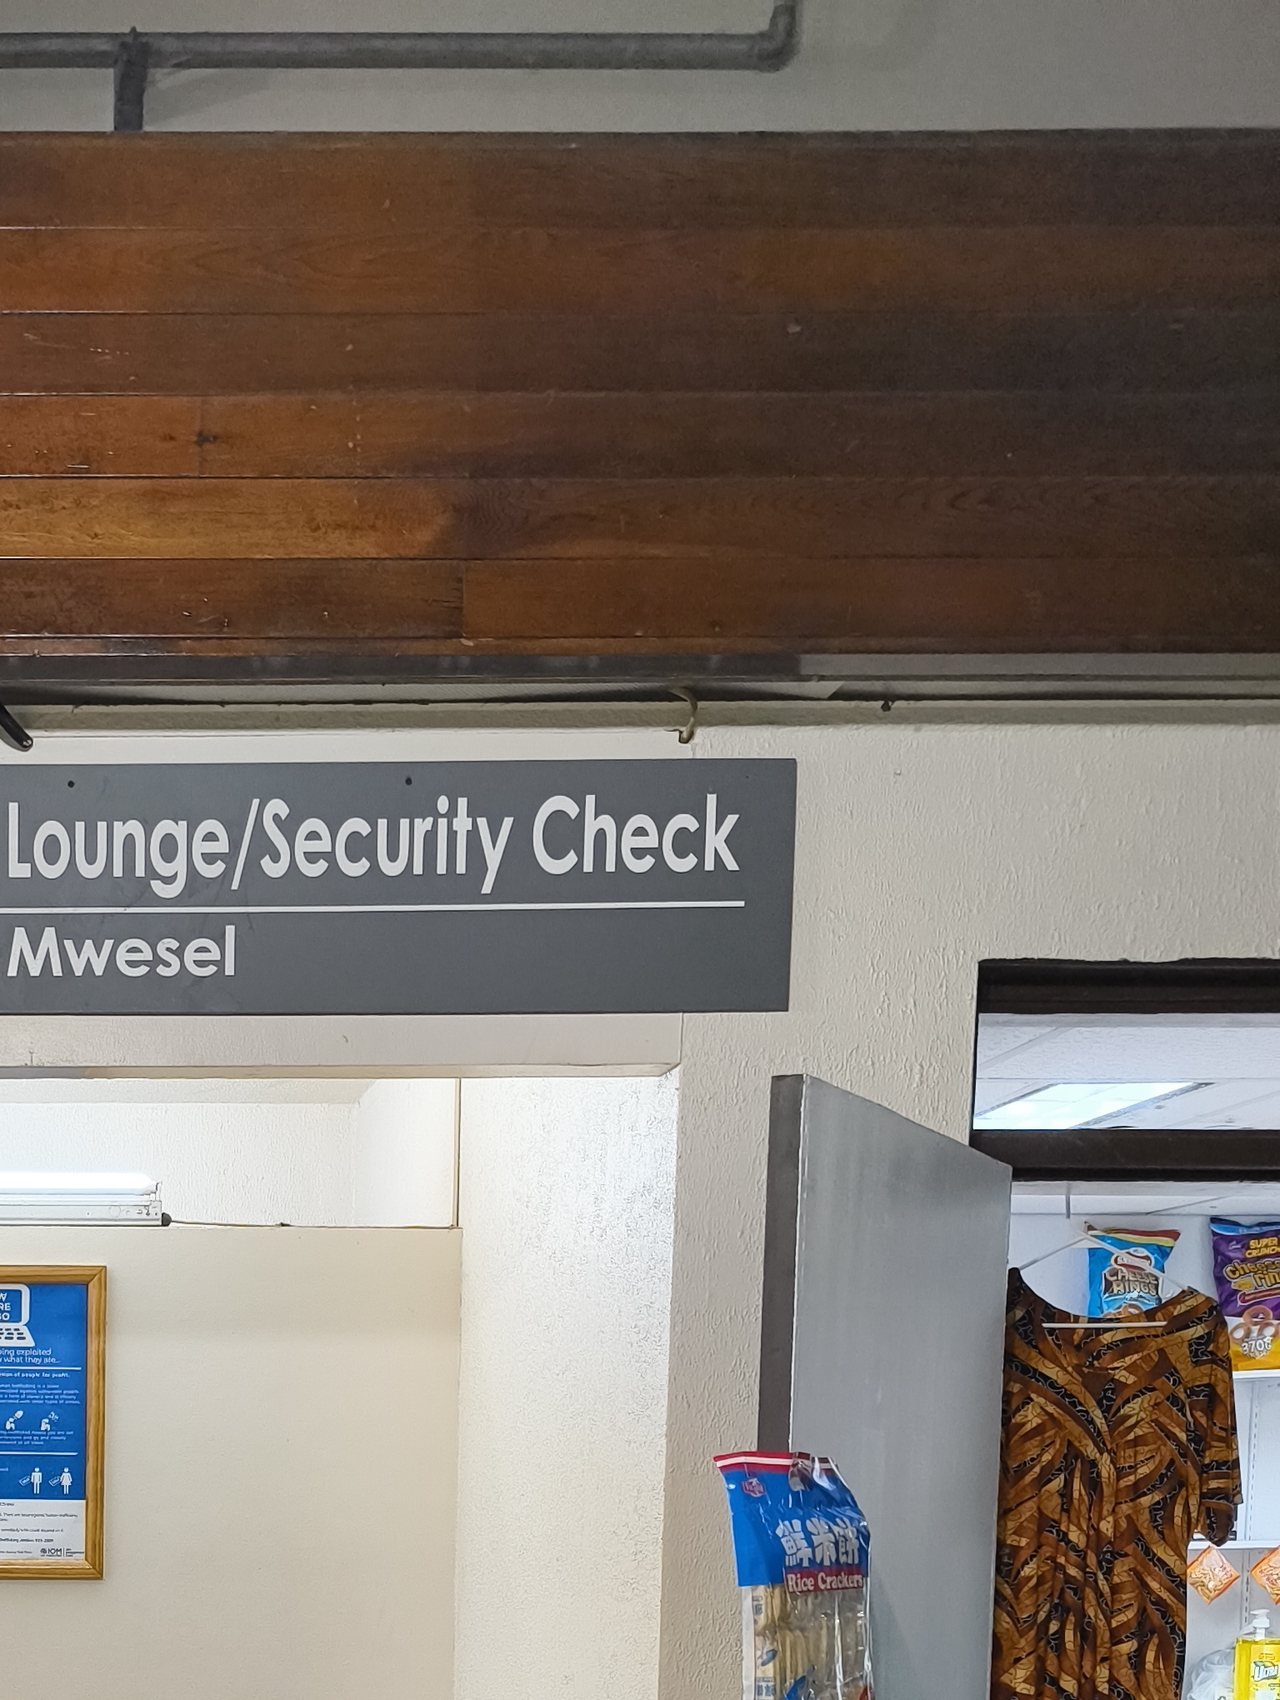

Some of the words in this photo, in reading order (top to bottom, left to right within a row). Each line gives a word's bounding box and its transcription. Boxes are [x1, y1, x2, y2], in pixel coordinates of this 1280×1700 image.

[9, 794, 512, 894] Lounge/Security
[533, 793, 738, 873] Check
[7, 925, 234, 975] Mwesel
[787, 1573, 814, 1593] Rice
[818, 1571, 863, 1590] Crackers
